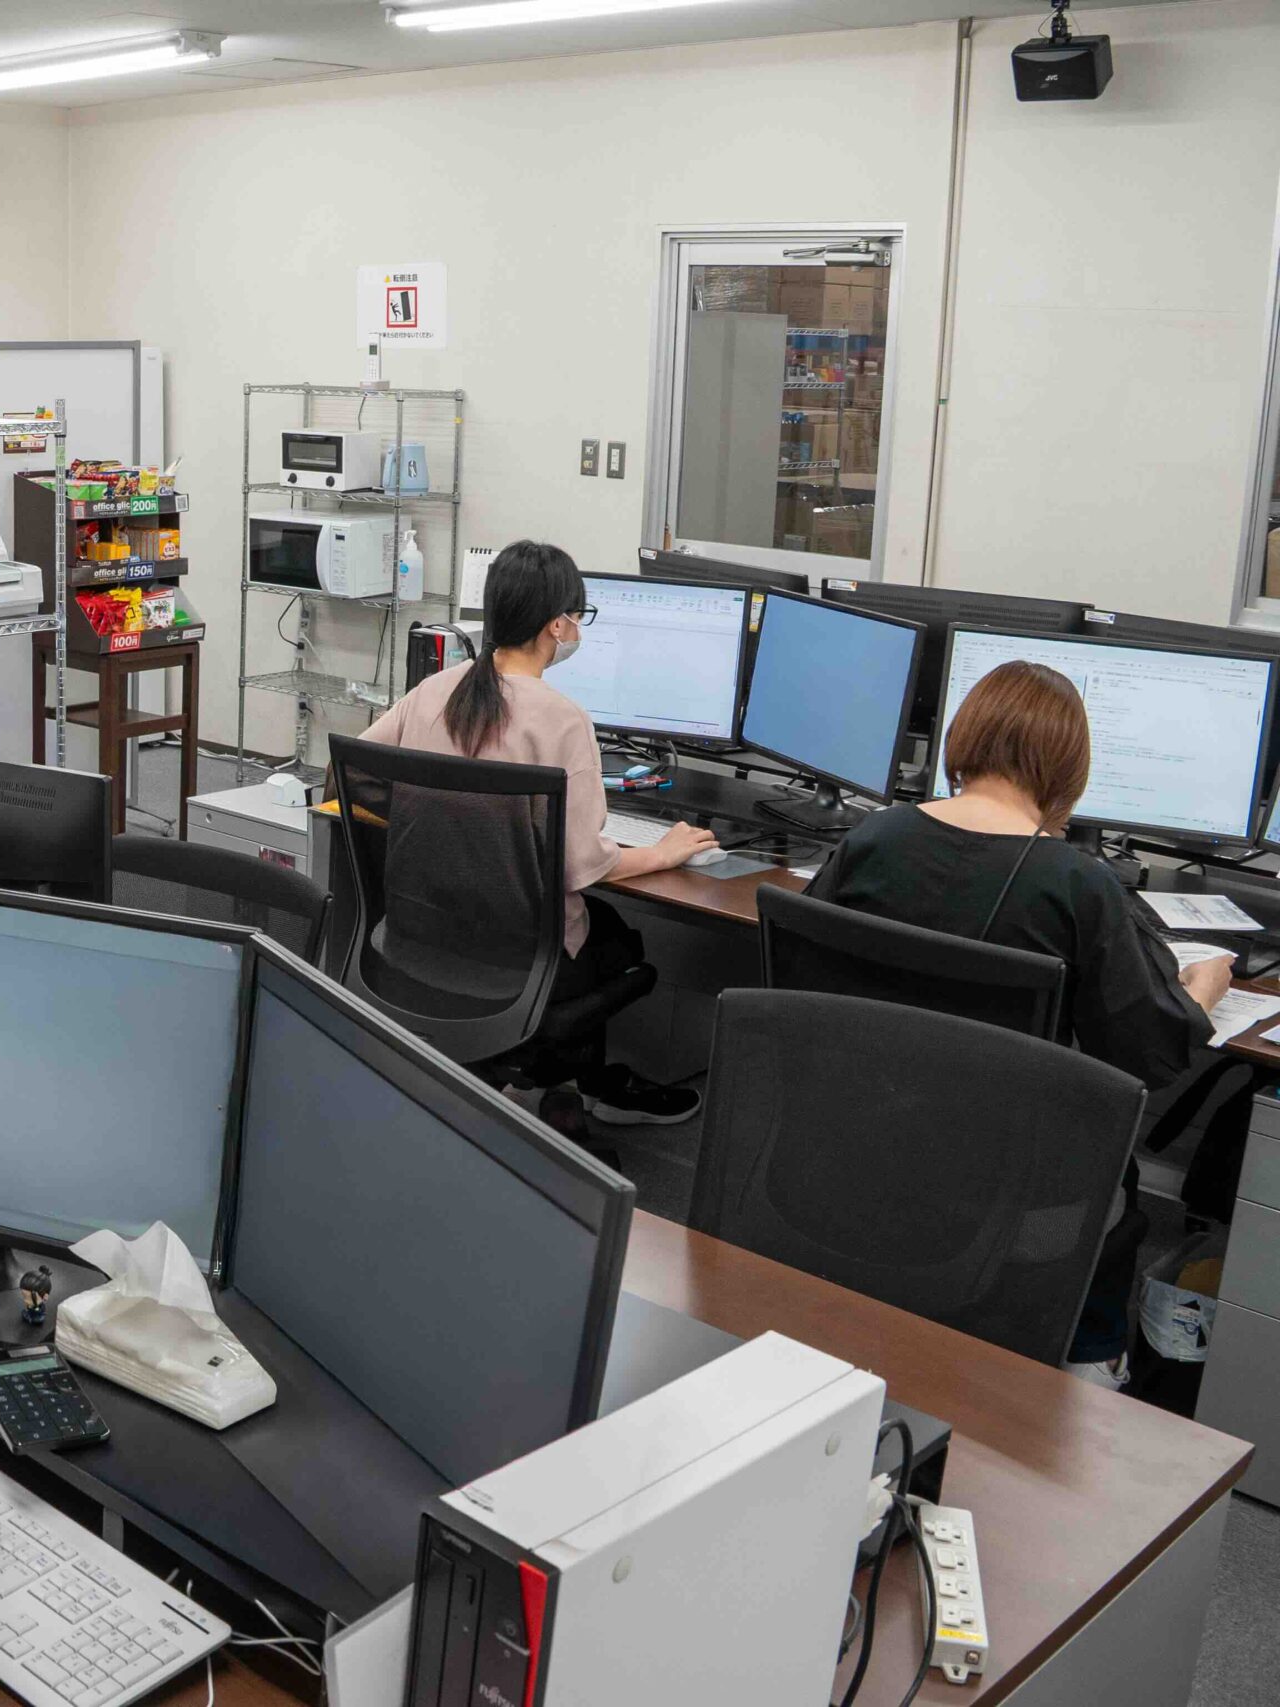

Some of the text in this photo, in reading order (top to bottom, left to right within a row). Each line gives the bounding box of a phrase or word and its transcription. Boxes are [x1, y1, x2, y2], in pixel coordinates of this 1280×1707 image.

[92, 501, 131, 511] office glic
[93, 566, 127, 577] office gli
